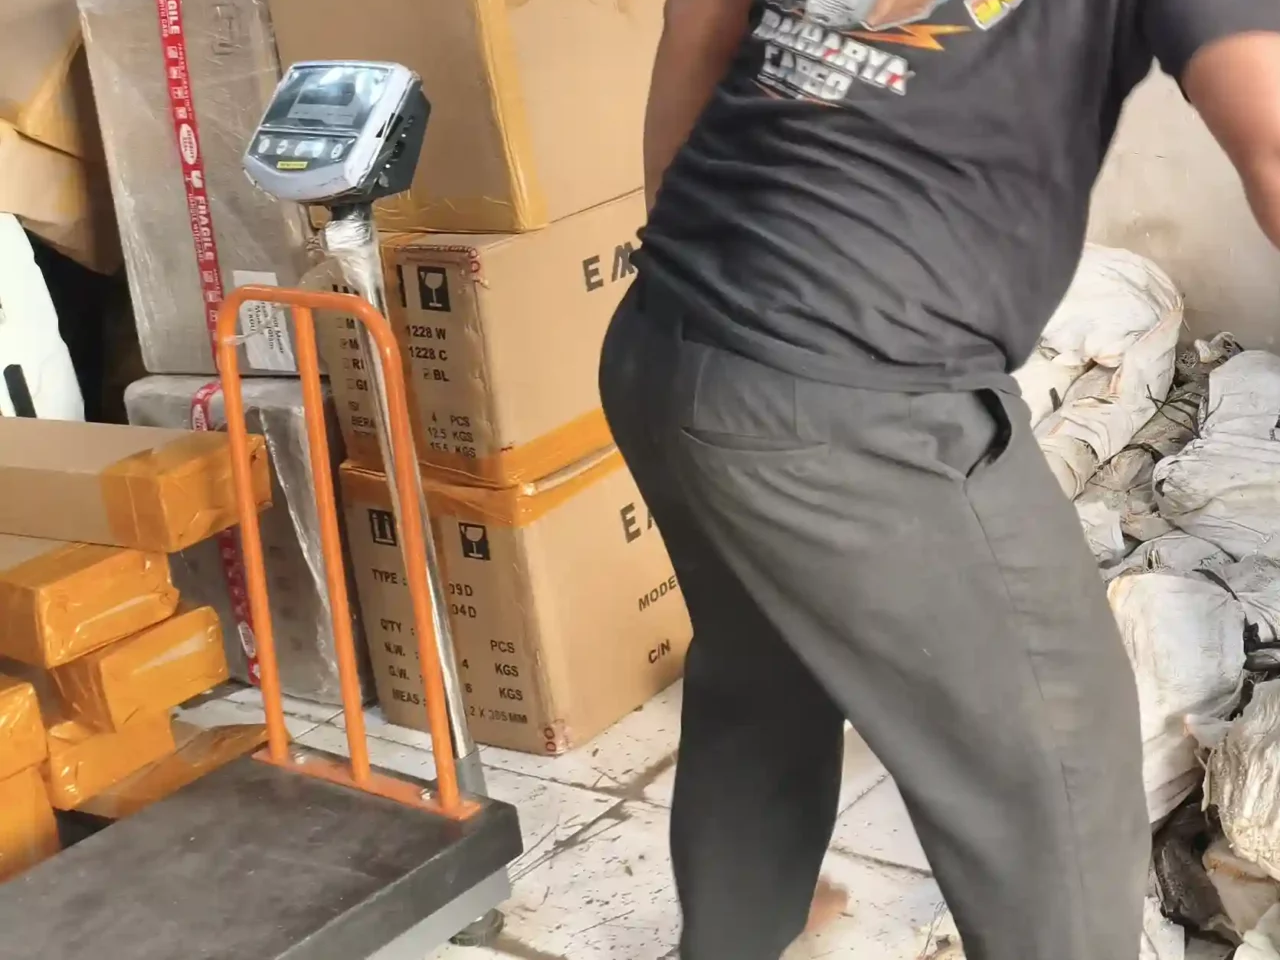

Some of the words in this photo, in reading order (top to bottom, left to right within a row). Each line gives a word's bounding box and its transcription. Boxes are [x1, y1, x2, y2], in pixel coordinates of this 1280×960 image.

[195, 196, 215, 261] FRAGILE
[406, 324, 432, 338] 1228
[435, 327, 446, 340] W
[408, 345, 436, 360] 1228
[438, 349, 448, 361] C
[351, 415, 376, 429] BERA
[450, 414, 471, 427] PCS
[452, 430, 474, 443] KGS
[455, 444, 477, 459] KGS
[371, 567, 398, 585] TYPE
[638, 574, 679, 612] MODE
[380, 618, 402, 633] QTY
[490, 639, 516, 654] PCS
[648, 638, 672, 665] C/N
[494, 662, 520, 677] KGS
[498, 686, 524, 701] KGS
